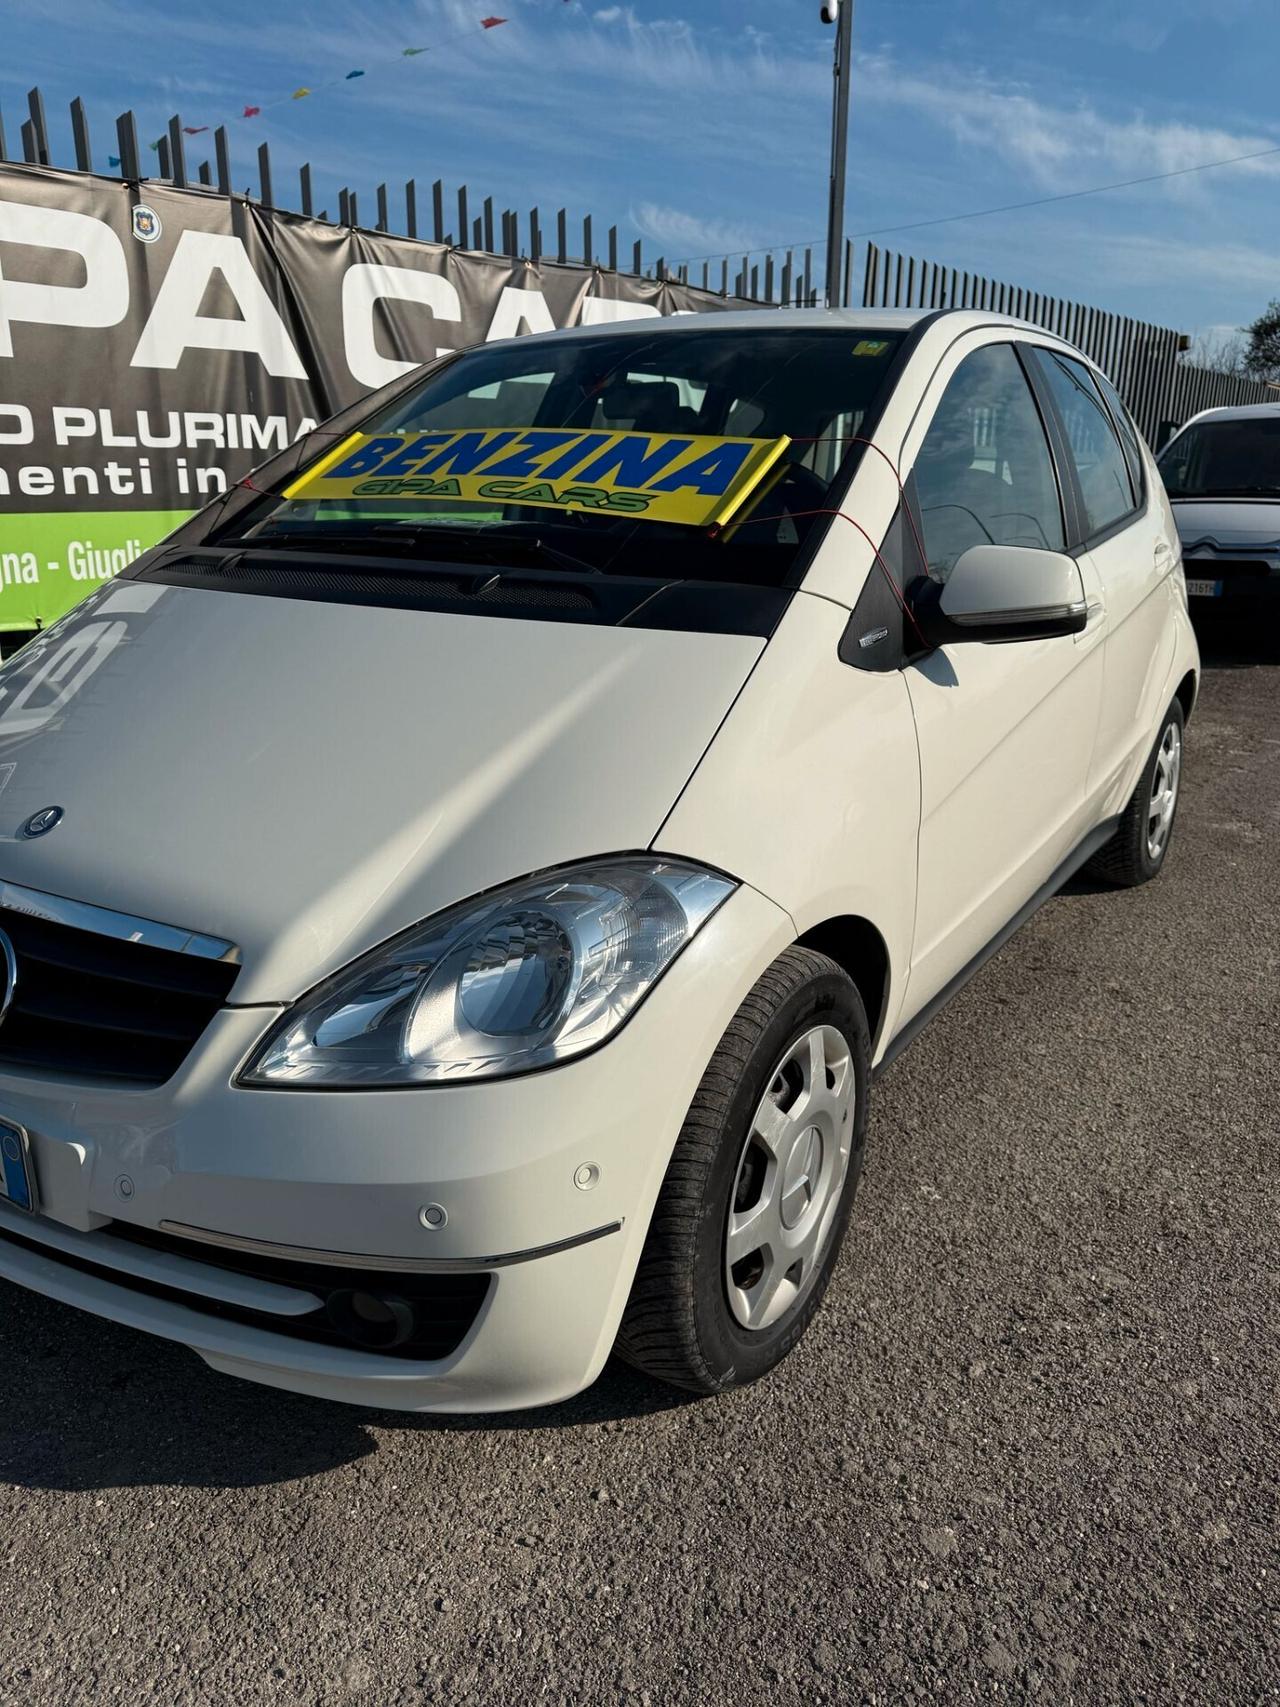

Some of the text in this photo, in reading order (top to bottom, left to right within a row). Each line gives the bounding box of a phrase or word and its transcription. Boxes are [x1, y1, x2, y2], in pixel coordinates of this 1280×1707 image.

[177, 458, 227, 494] in
[319, 431, 754, 497] BENZINA
[352, 478, 661, 513] GIPA CARS
[0, 552, 40, 593] na
[67, 539, 150, 581] Giugli
